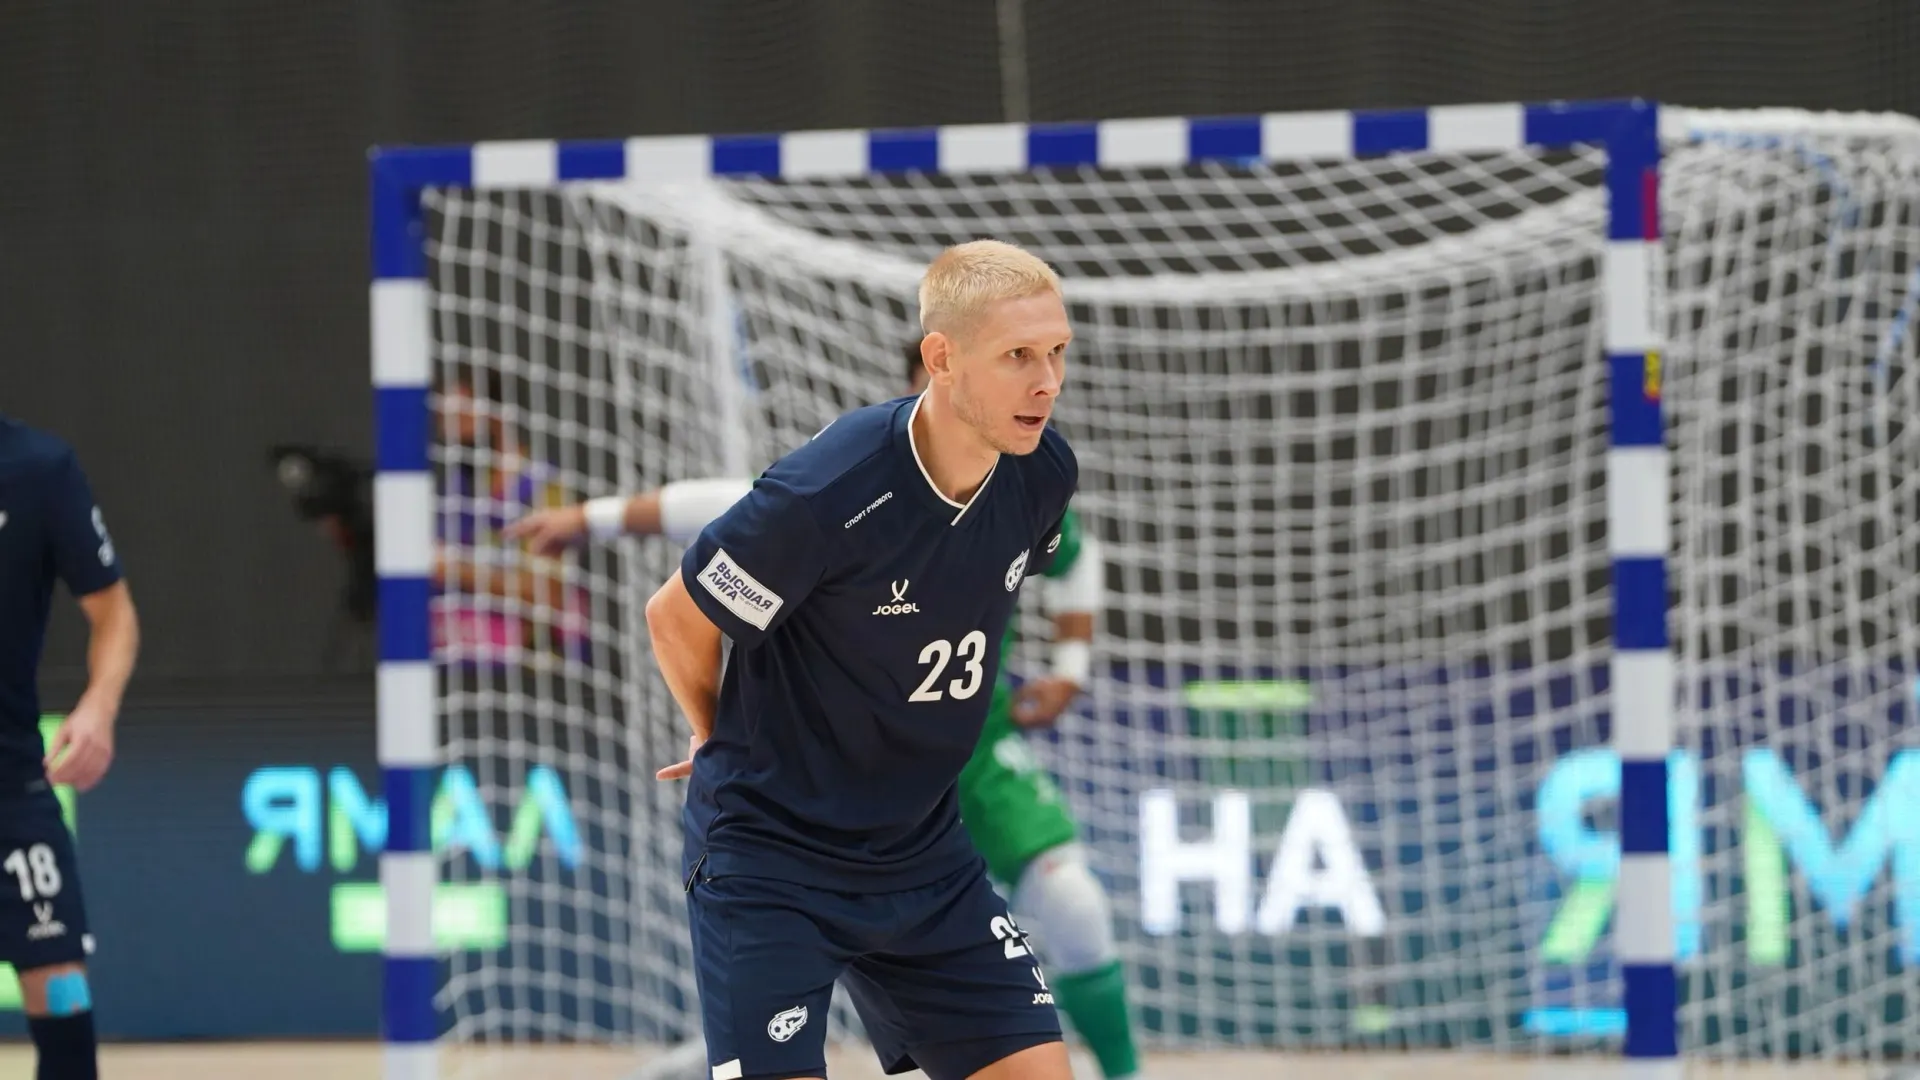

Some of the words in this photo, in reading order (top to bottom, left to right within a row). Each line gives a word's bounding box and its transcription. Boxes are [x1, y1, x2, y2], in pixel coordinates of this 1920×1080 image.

[844, 509, 866, 529] СПОРТ
[707, 571, 738, 601] ЛИГА
[715, 561, 774, 610] ВЫСШАЯ
[872, 602, 920, 616] JOGEL
[907, 629, 987, 703] 23
[3, 842, 63, 902] 18
[1139, 788, 1387, 936] НА
